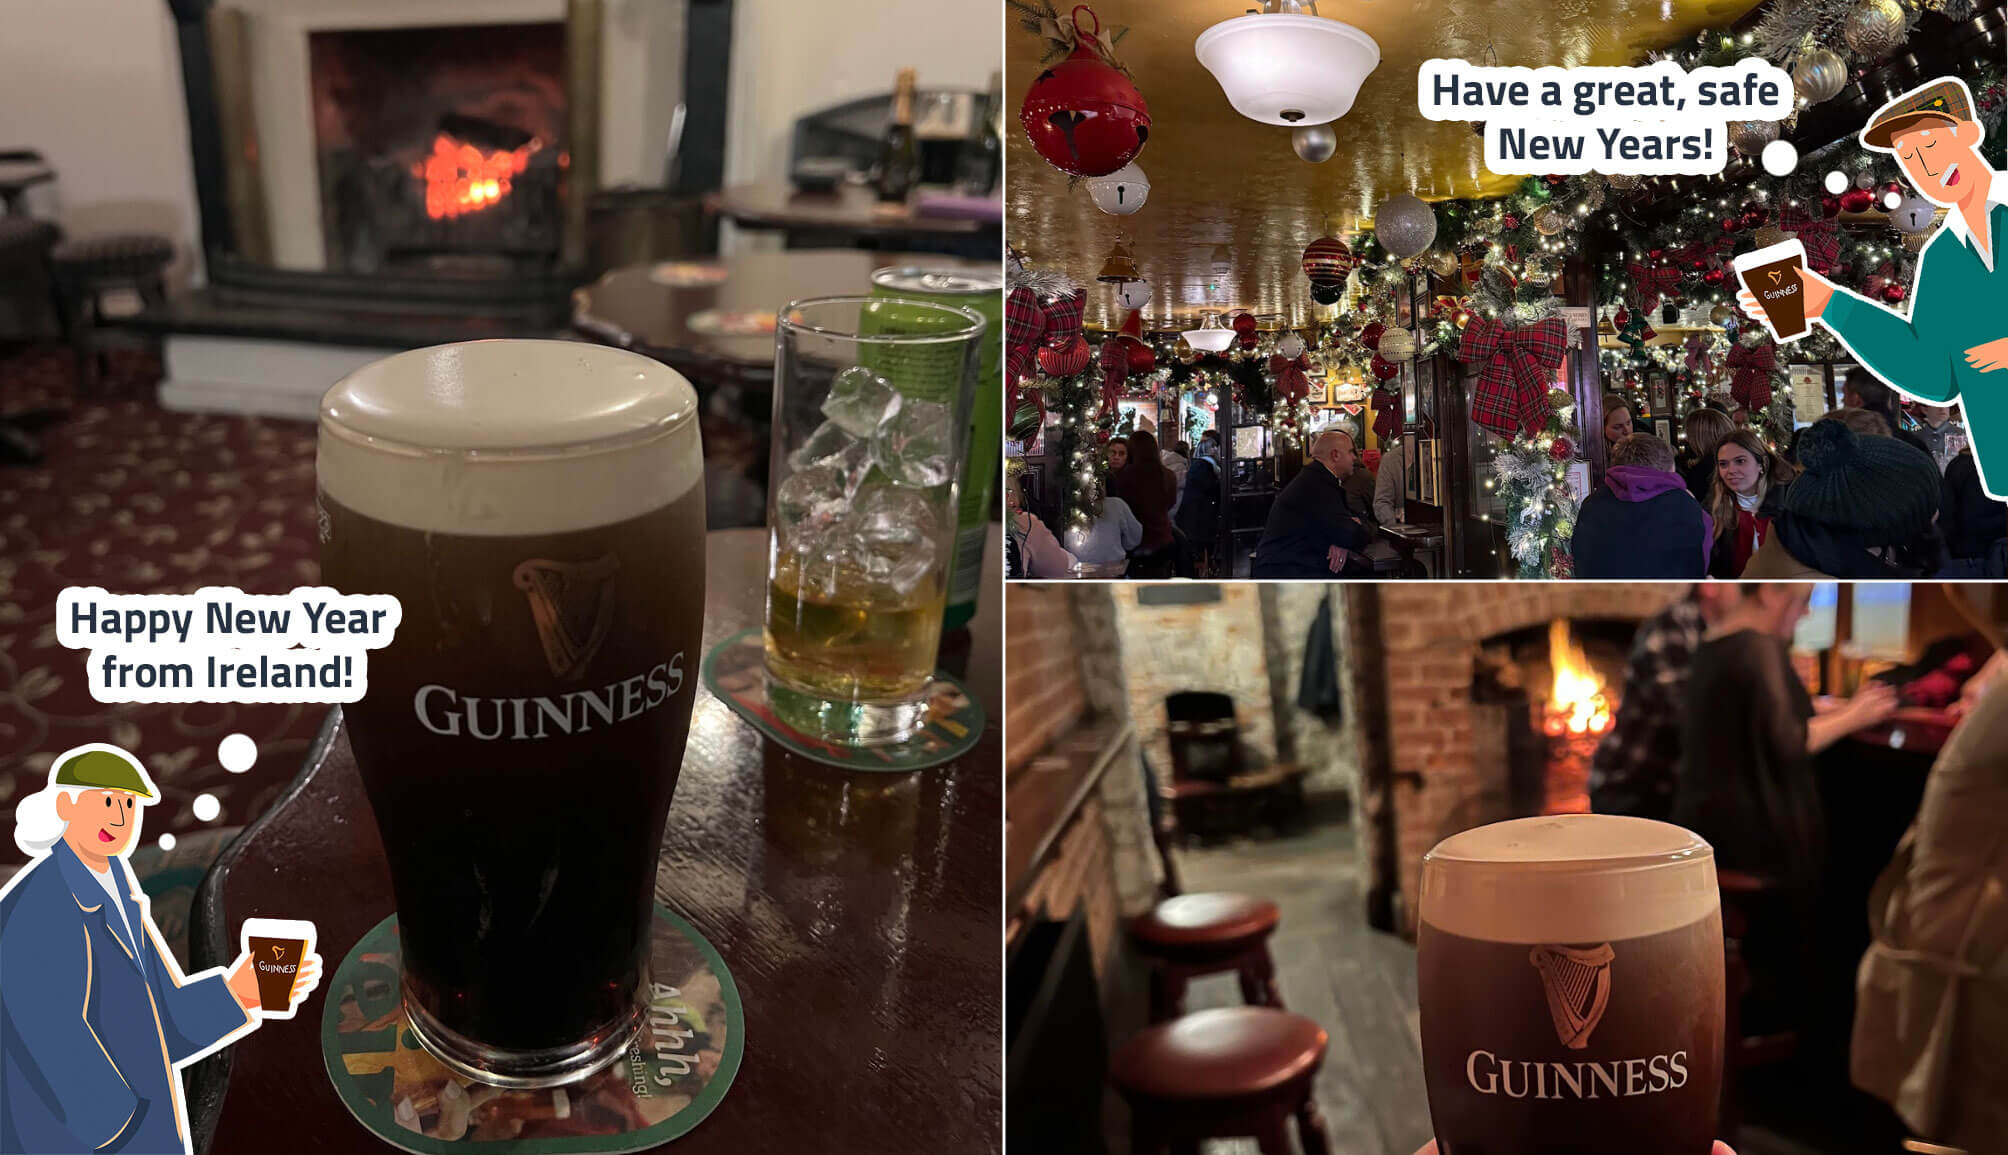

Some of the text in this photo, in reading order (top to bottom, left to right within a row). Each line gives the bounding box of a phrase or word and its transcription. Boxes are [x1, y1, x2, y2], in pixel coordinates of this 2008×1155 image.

[413, 650, 685, 741] GUINNESS
[647, 982, 700, 1087] Ahhh,
[1466, 1049, 1689, 1099] GUINNESS
